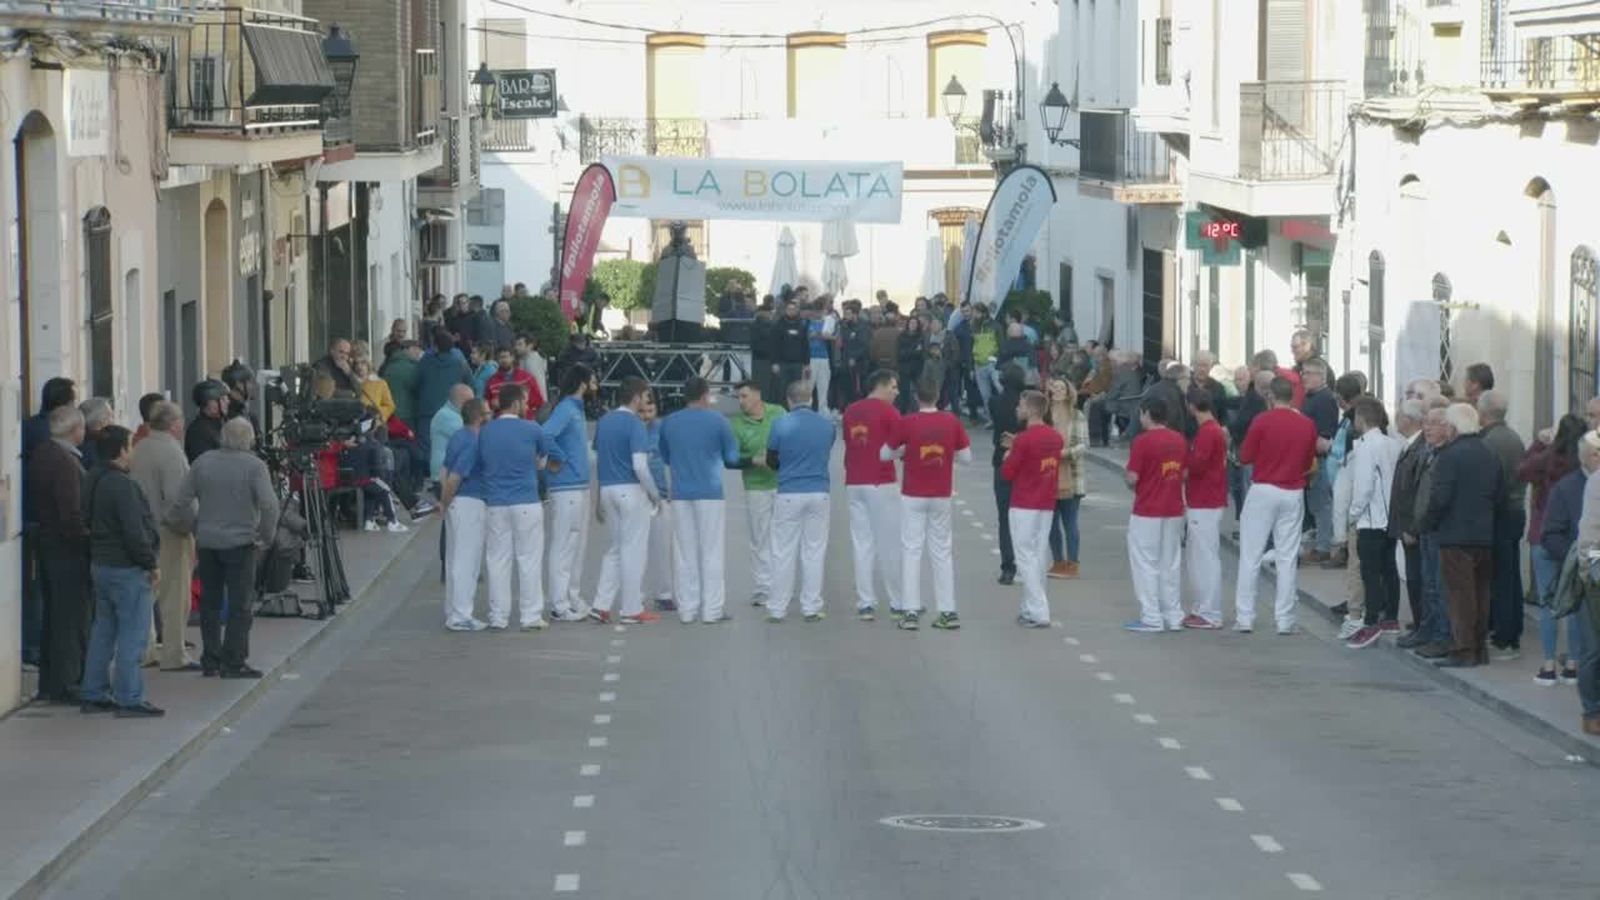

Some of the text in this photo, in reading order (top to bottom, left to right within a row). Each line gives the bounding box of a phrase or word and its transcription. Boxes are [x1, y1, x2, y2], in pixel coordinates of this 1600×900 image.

[500, 78, 530, 94] BAR
[500, 96, 551, 110] Escales
[672, 169, 894, 198] LA BOLATA
[563, 173, 605, 280] #pilotamola
